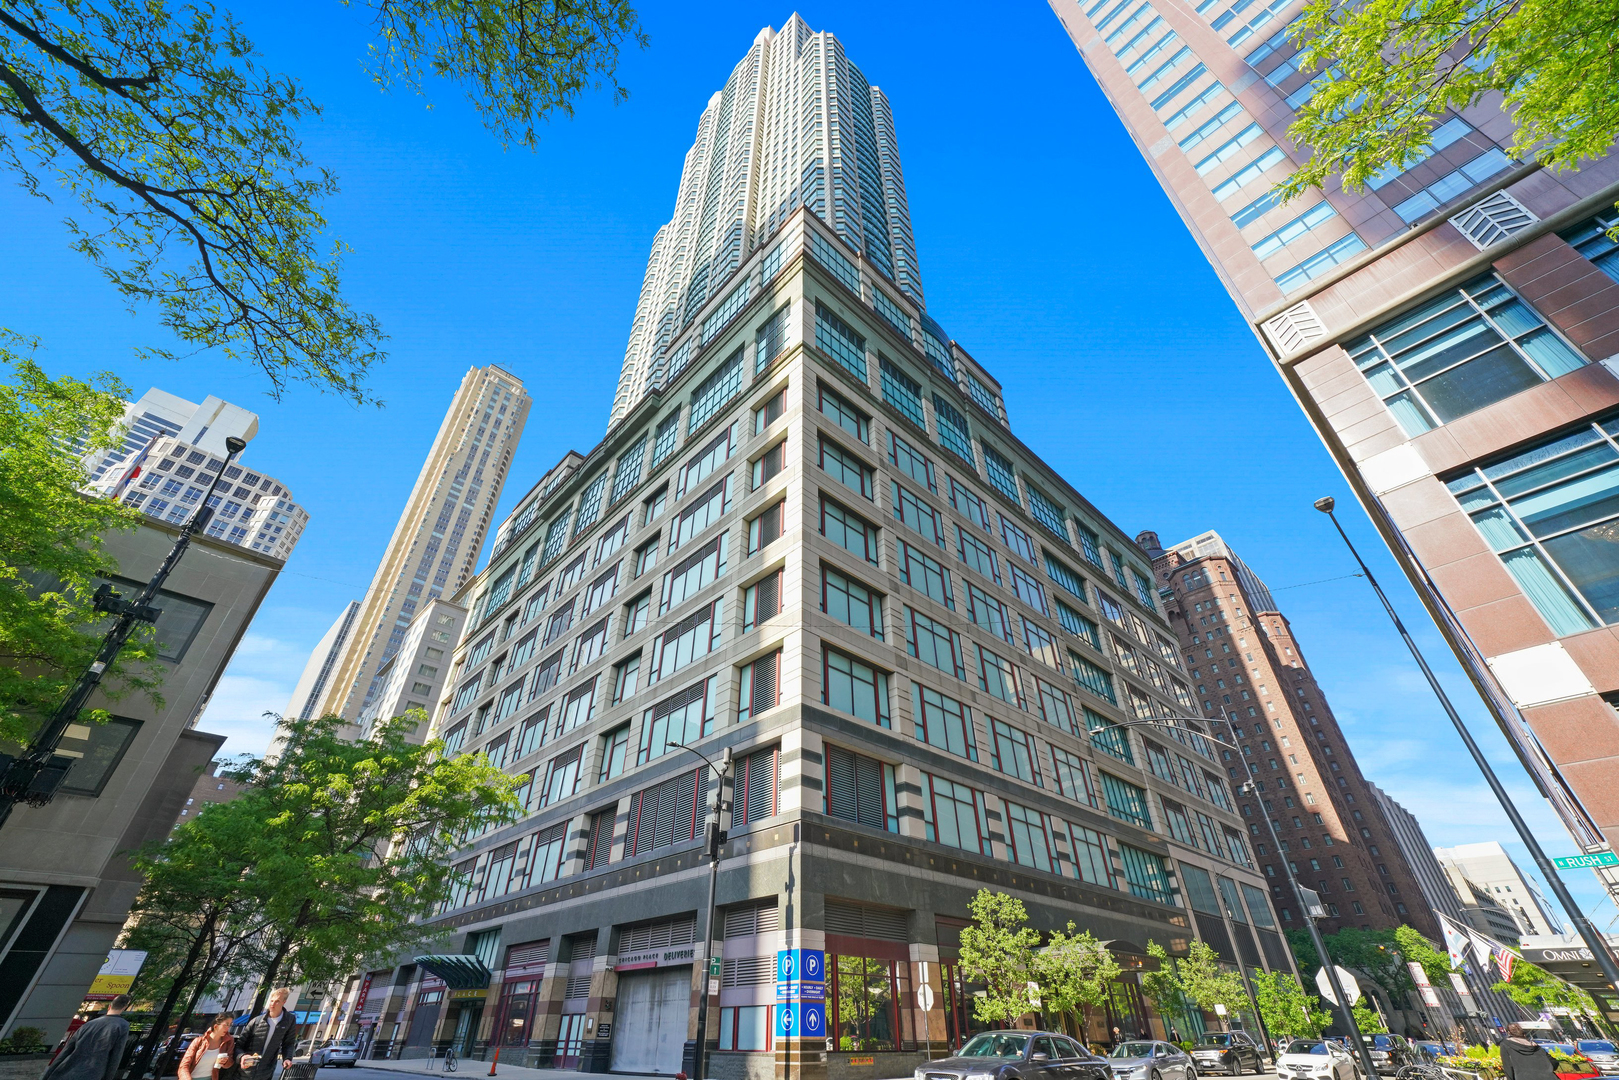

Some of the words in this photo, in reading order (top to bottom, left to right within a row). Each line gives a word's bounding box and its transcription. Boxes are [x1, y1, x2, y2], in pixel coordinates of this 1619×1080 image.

[1565, 855, 1602, 868] RUSH
[664, 949, 695, 961] DELIVERIE
[1543, 949, 1580, 961] OMNI
[810, 959, 816, 971] P
[106, 982, 130, 990] Spoon
